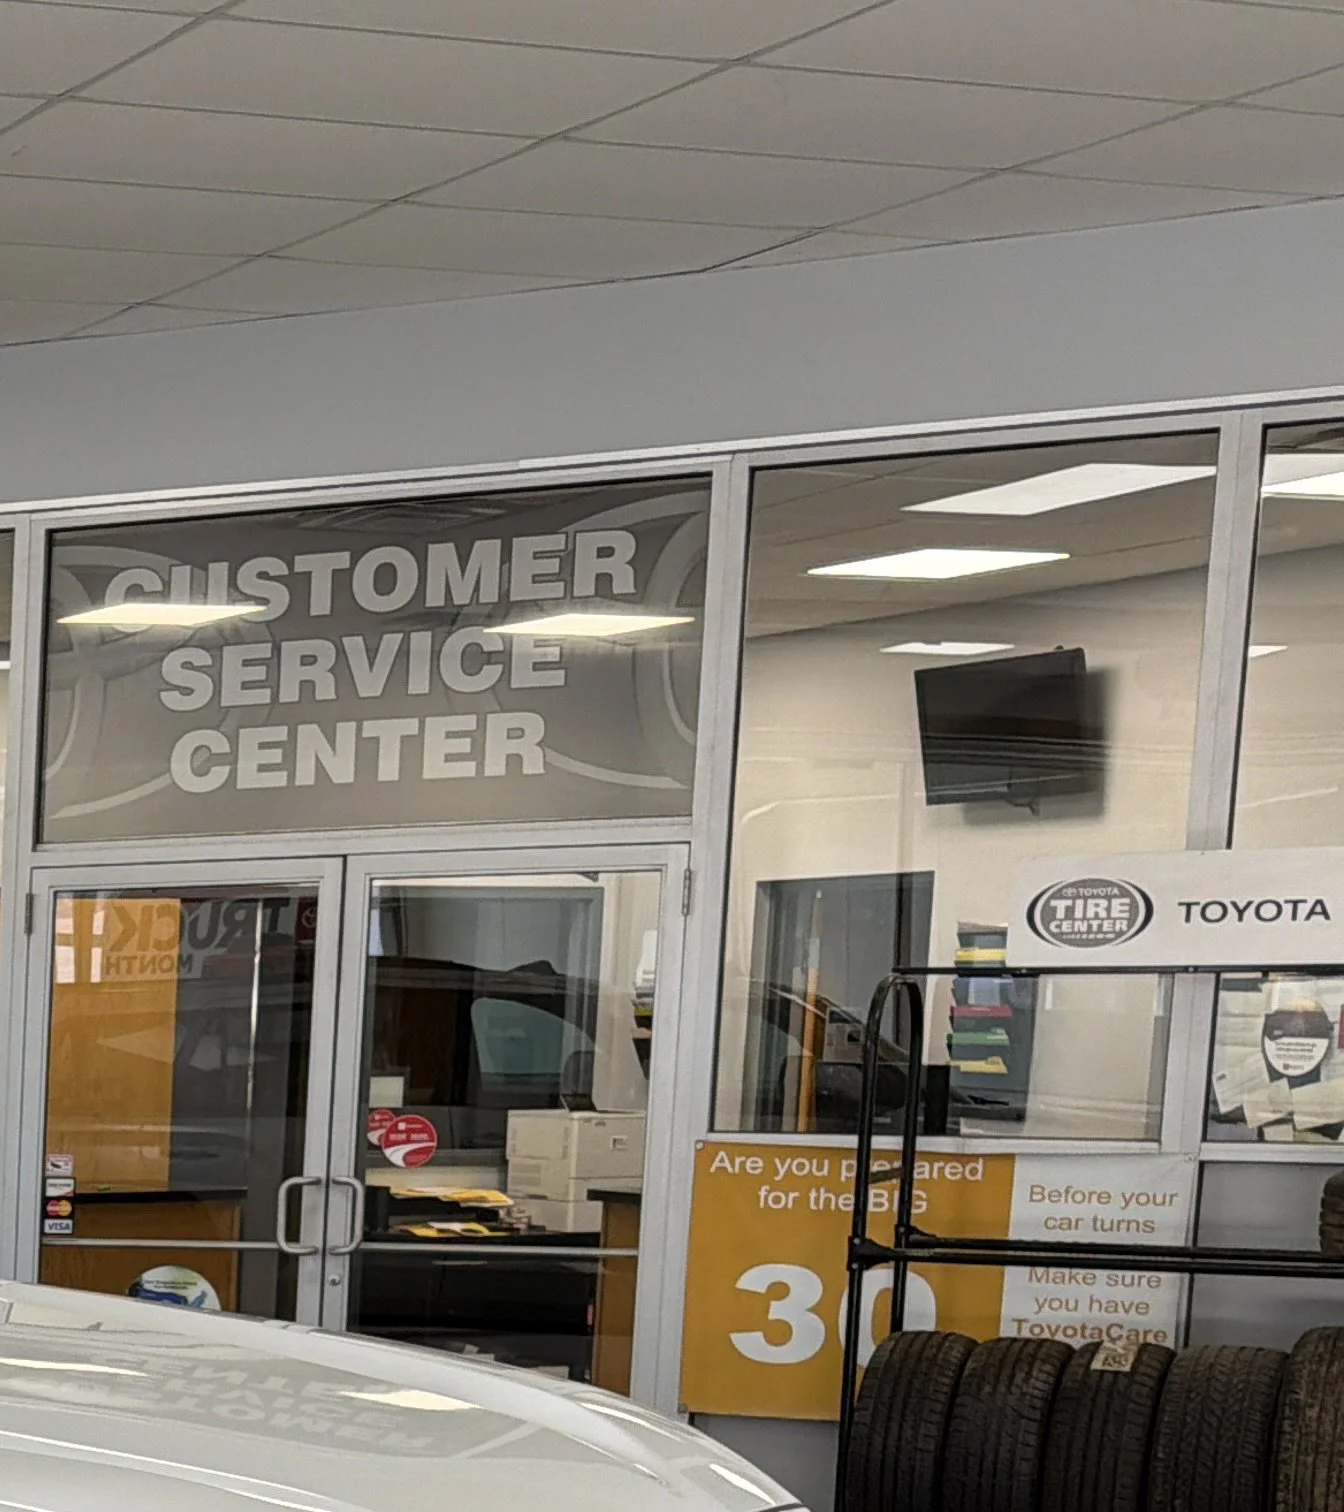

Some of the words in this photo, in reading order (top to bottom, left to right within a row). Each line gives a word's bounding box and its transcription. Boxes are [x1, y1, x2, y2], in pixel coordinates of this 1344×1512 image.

[104, 530, 636, 633] CUSTOMER
[160, 627, 567, 712] SERVICE
[170, 712, 545, 793] CENTER
[1078, 887, 1120, 897] TOYOTA
[1050, 897, 1131, 919] TIRE
[1178, 899, 1331, 923] TOYOTA
[1049, 920, 1129, 933] CENTER
[710, 1151, 764, 1174] Are
[774, 1157, 829, 1181] you
[840, 1157, 984, 1184] peared
[758, 1186, 800, 1209] for
[809, 1187, 856, 1212] the
[868, 1188, 928, 1214] BIG
[1029, 1185, 1112, 1205] Before
[1120, 1191, 1179, 1210] your
[47, 1222, 71, 1231] VISA
[1043, 1216, 1084, 1231] car
[1092, 1214, 1156, 1234] turns
[1028, 1266, 1097, 1286] Make
[1106, 1273, 1162, 1289] sure
[729, 1263, 937, 1367] 30
[1033, 1296, 1079, 1315] you
[1088, 1294, 1150, 1316] have
[1011, 1318, 1168, 1345] ToyotaCare
